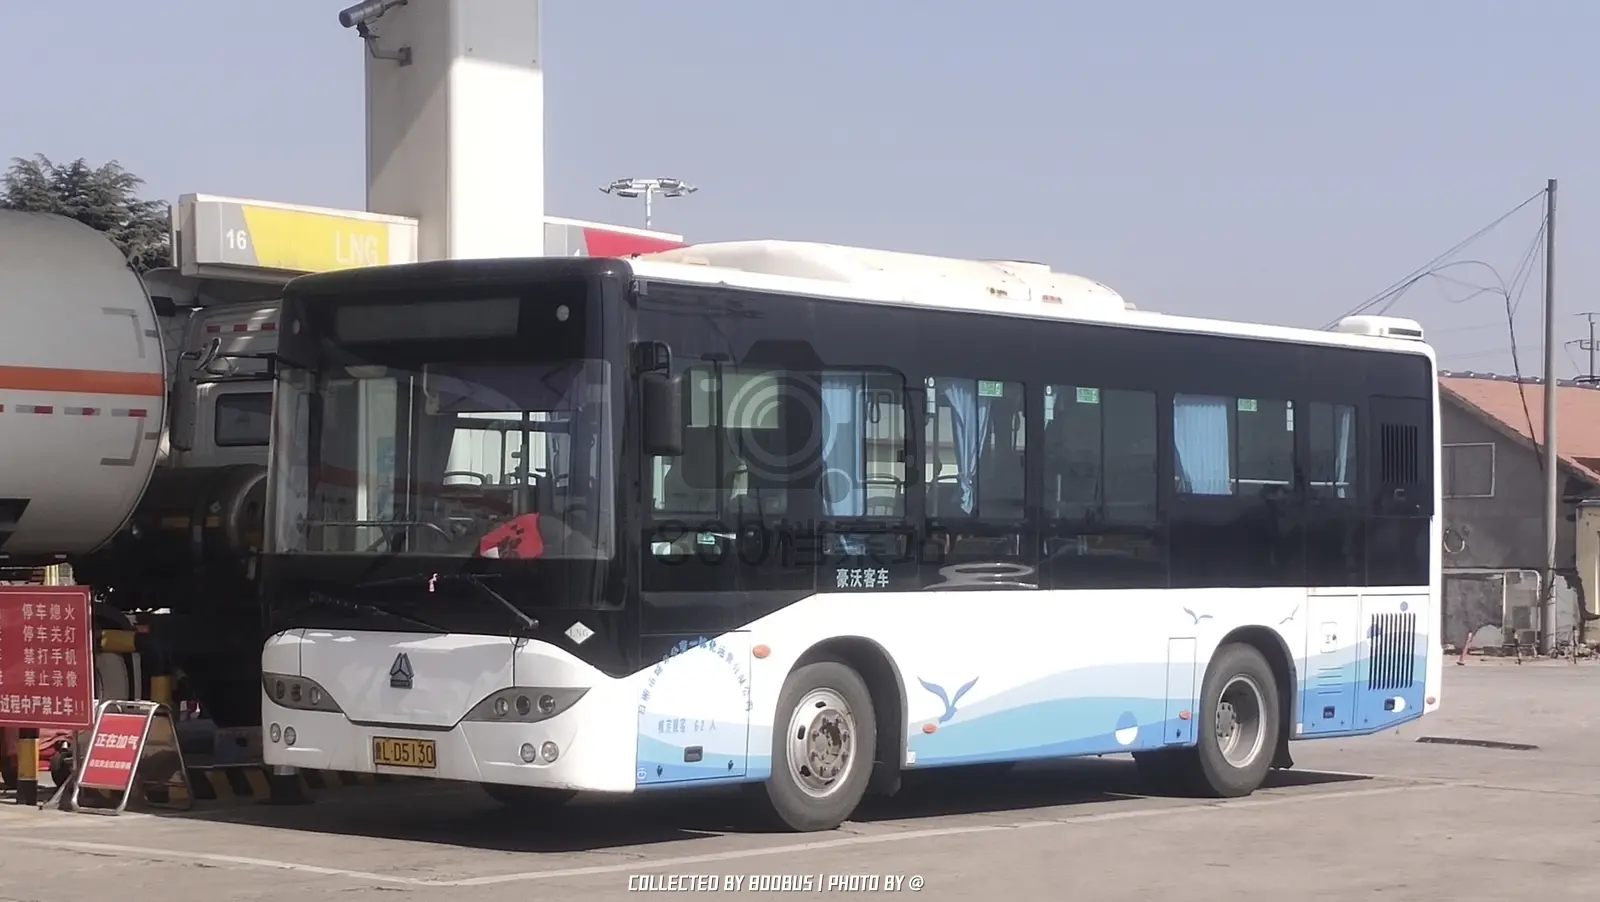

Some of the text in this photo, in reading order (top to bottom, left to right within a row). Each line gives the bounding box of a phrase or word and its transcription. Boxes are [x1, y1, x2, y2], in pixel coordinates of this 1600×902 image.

[226, 228, 248, 250] 16
[335, 230, 379, 266] LNG
[835, 567, 890, 588] 豪沃客车
[22, 602, 76, 620] 停车熄火
[22, 624, 76, 643] 停车关灯
[23, 646, 77, 665] 禁打手机
[24, 669, 78, 688] 禁止录像
[94, 733, 140, 751] 正在加气
